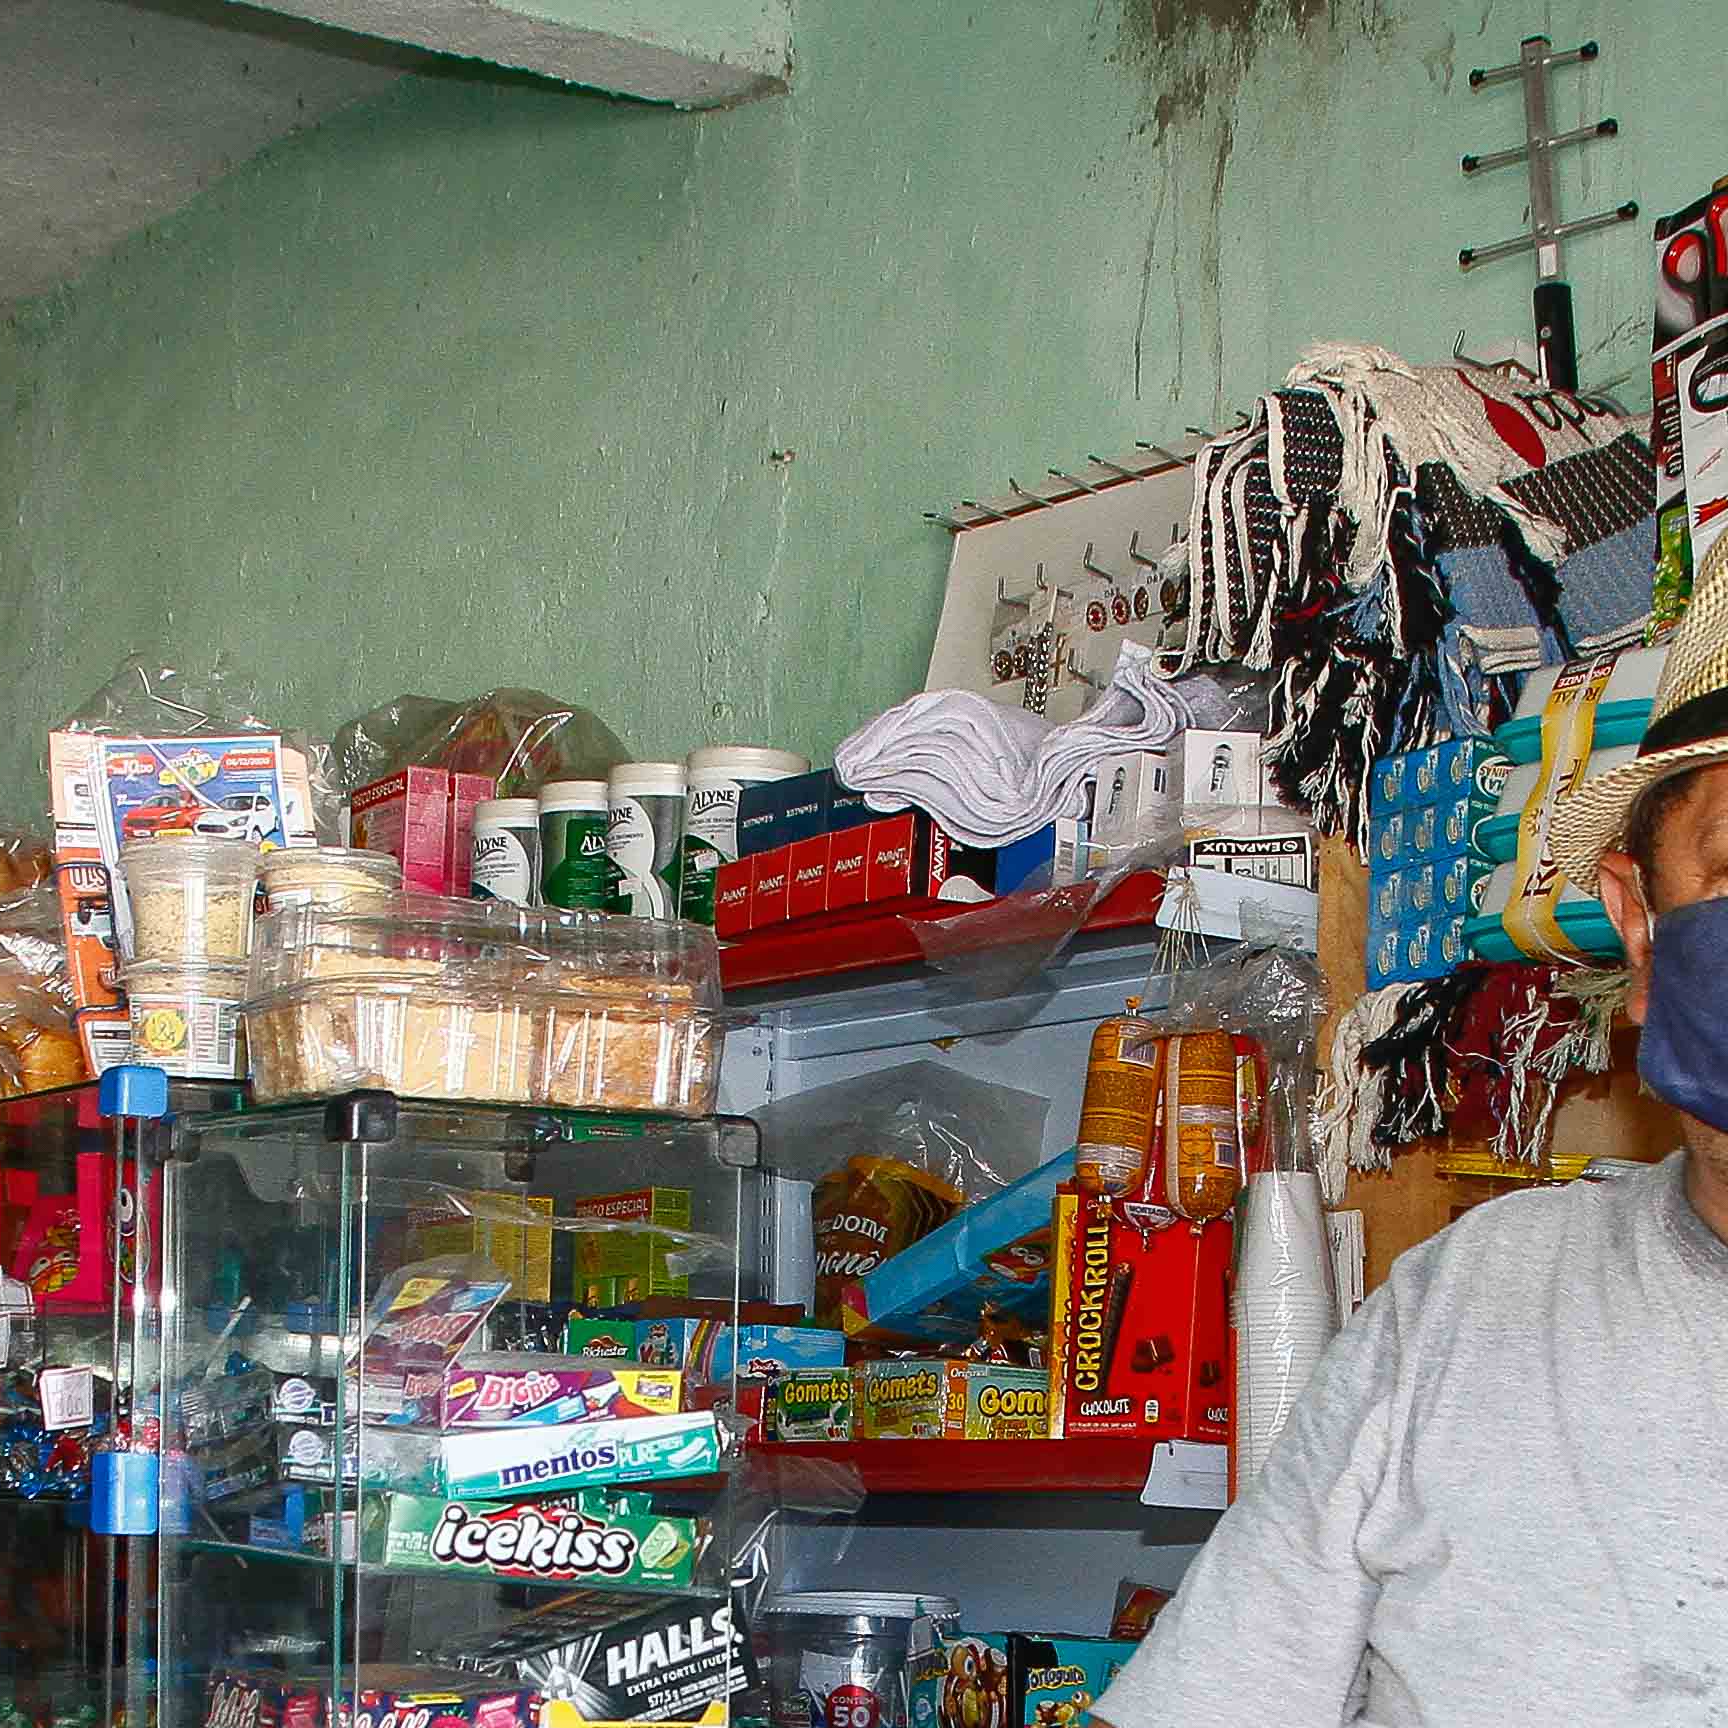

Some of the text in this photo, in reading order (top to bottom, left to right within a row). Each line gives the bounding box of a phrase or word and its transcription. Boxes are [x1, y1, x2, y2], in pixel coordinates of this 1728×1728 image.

[691, 787, 737, 815] ALYNE
[475, 836, 507, 856] ALYNE
[582, 834, 606, 856] ALY
[931, 829, 946, 882] AVANT
[1202, 841, 1281, 853] EMPALUX
[834, 855, 863, 873] AVANT
[875, 847, 906, 865] AVANT
[757, 875, 784, 892] AVANT
[796, 864, 824, 882] AVANT
[721, 886, 748, 903] AVANT
[784, 1380, 849, 1404] Gomets
[869, 1370, 938, 1402] Gomets
[947, 1393, 965, 1412] 30
[980, 1386, 1048, 1416] Gom
[1080, 1397, 1130, 1418] CHOCOLATE
[500, 1444, 615, 1488] mentos
[619, 1444, 663, 1468] PURE
[432, 1500, 639, 1576] icekiss
[627, 1675, 661, 1697] EXTRA
[662, 1663, 697, 1686] FORTE
